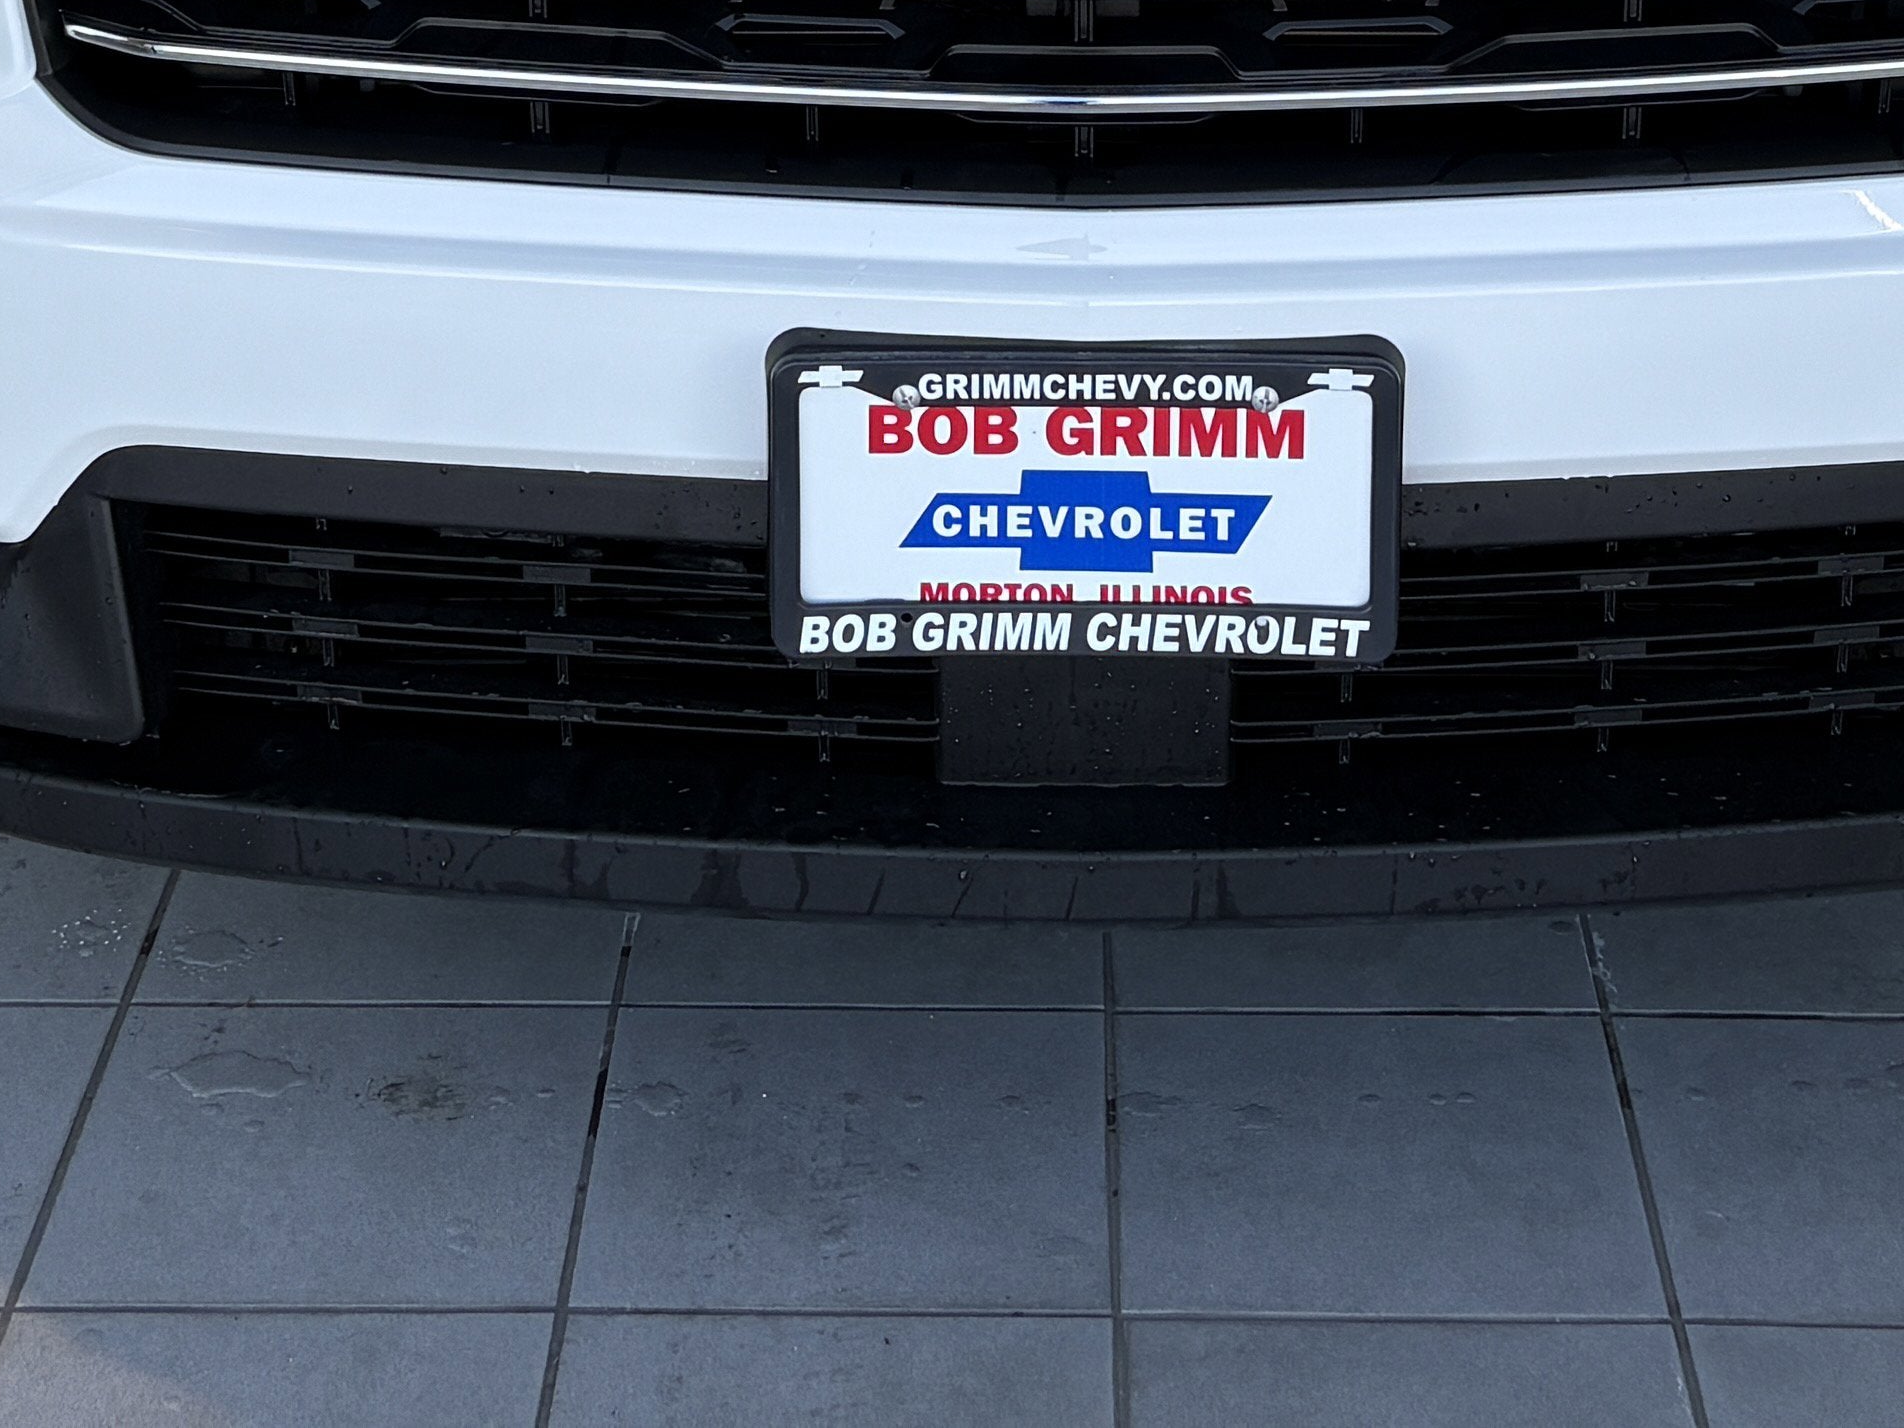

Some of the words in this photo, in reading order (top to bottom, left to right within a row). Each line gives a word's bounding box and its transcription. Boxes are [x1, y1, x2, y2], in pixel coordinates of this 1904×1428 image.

[918, 373, 1253, 401] GRIMMCHEVY.COM
[868, 404, 1019, 456] BOB
[1045, 405, 1305, 460] GRIMM
[932, 504, 1236, 541] CHEVROLET
[920, 582, 1074, 603] MORTON
[1099, 584, 1254, 605] ILLINOIS
[799, 613, 896, 654] BOB
[912, 612, 1073, 652] GRIMM
[1086, 612, 1371, 658] CHEVROLET
